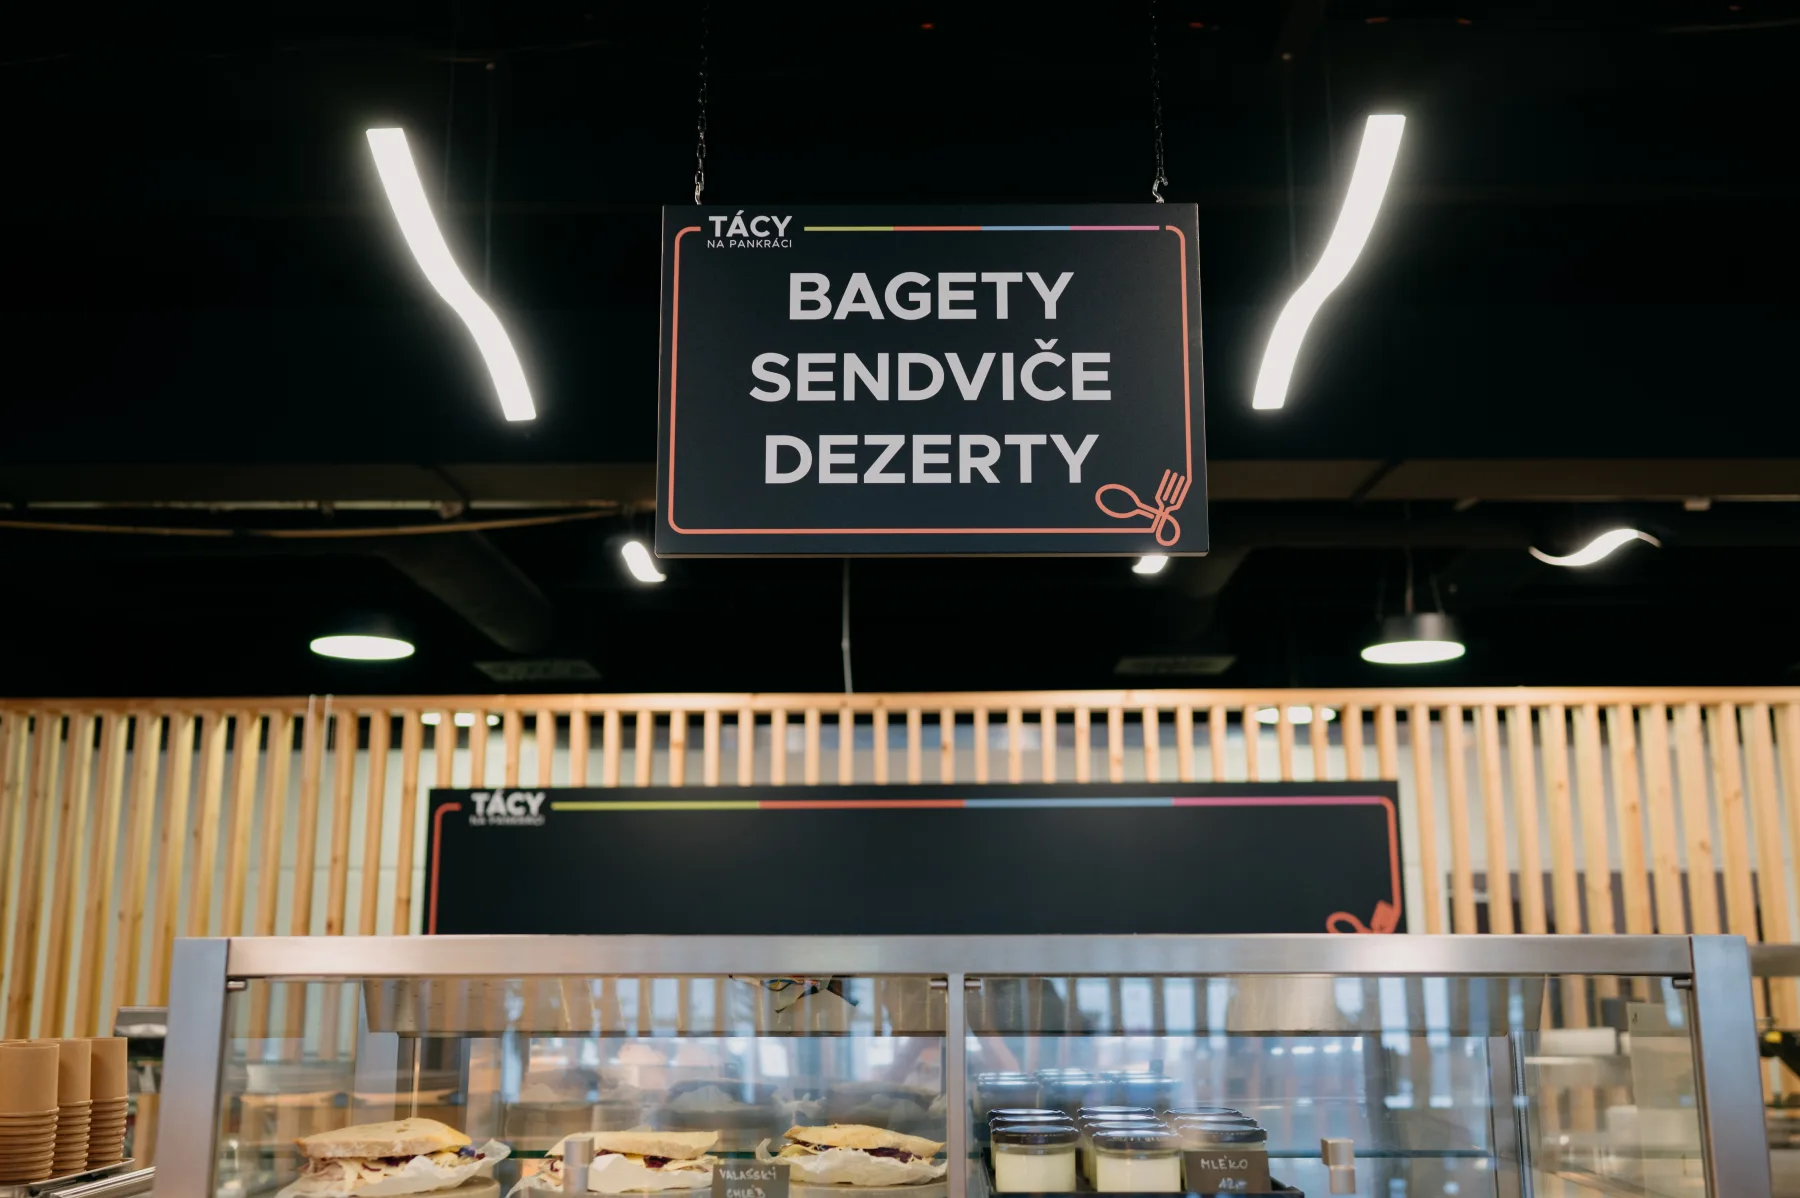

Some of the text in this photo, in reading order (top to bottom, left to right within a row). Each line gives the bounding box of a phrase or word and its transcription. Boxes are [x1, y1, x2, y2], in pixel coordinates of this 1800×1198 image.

[708, 209, 792, 237] TÁCY
[707, 238, 792, 248] NA PANKRÁCI
[789, 272, 1075, 320] BAGETY
[749, 338, 1112, 402] SENDVIČE
[764, 434, 1100, 484] DEZERTY
[470, 789, 546, 817] TÁCY
[1200, 1155, 1248, 1169] MLÉKO
